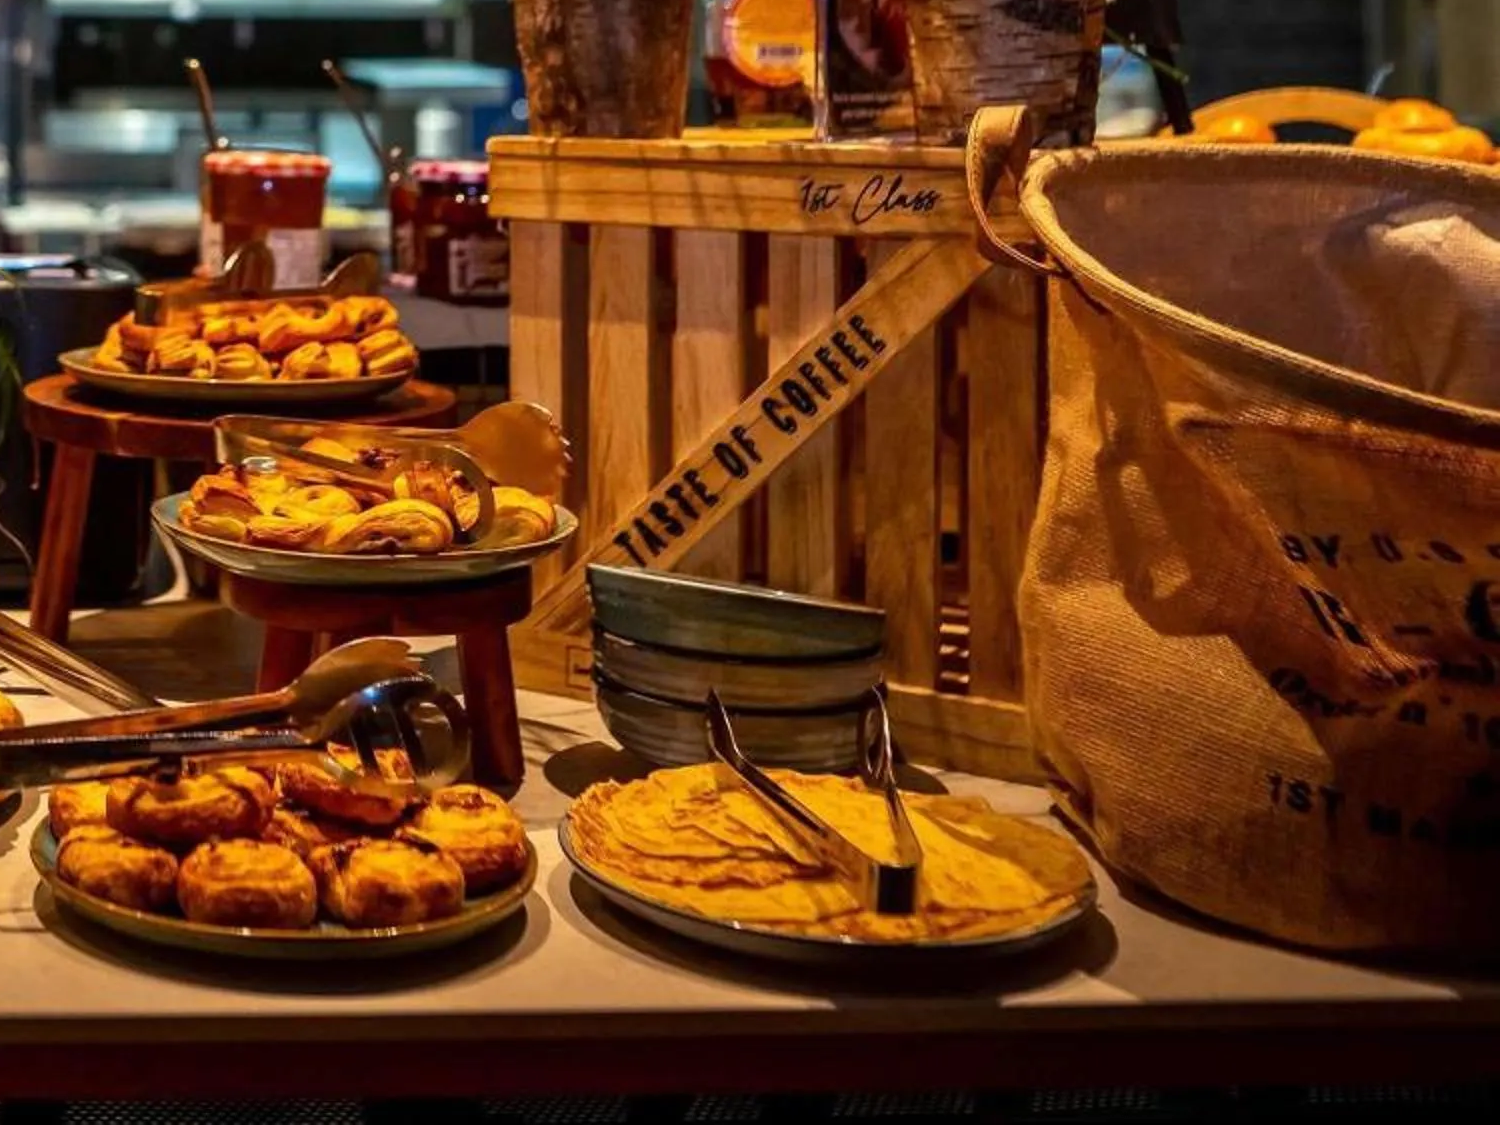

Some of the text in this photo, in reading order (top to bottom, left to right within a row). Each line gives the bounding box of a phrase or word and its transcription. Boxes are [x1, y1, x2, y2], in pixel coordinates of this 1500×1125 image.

[801, 175, 941, 225] 1st Class
[613, 313, 887, 567] TASTE OF COFFEE
